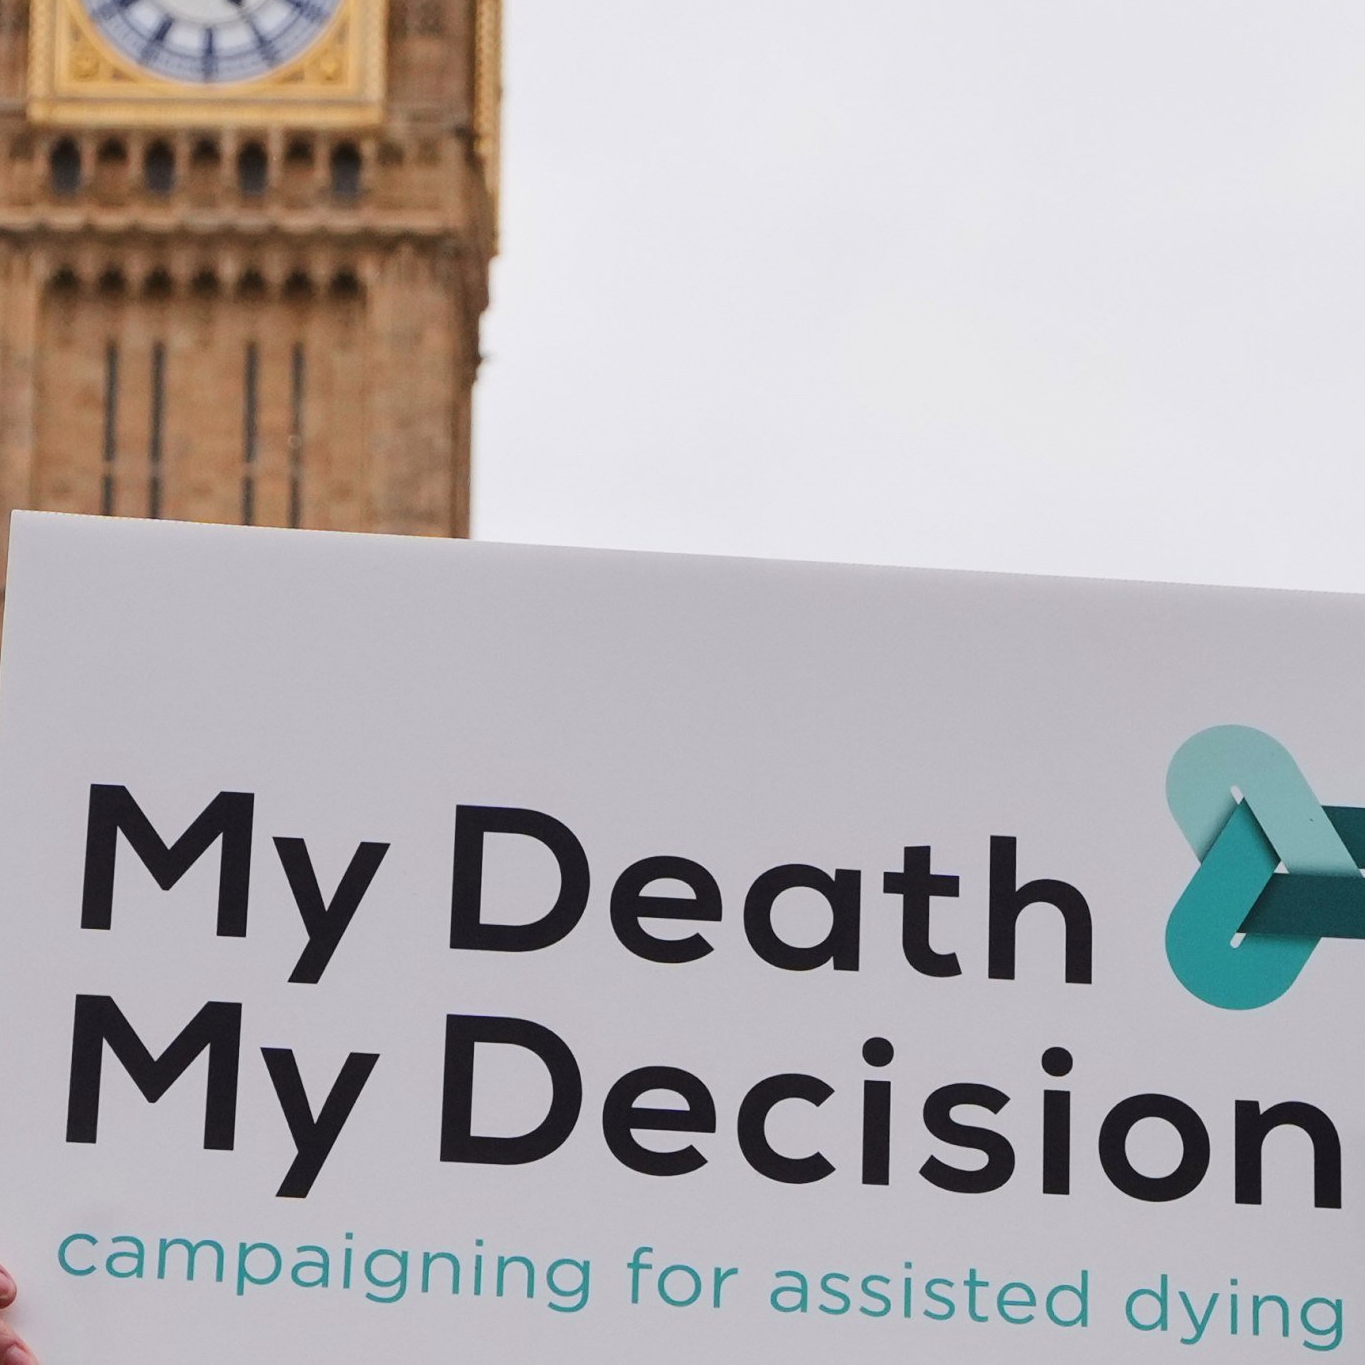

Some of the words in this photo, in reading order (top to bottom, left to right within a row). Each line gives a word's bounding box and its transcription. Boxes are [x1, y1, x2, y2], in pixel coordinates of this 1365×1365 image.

[81, 784, 390, 984] My
[450, 805, 1092, 984] Death
[66, 994, 380, 1198] My
[440, 1014, 1341, 1209] Decision
[58, 1232, 590, 1312] campaigning
[627, 1247, 738, 1308] for
[771, 1262, 1088, 1327] assisted
[1126, 1274, 1342, 1351] dying
